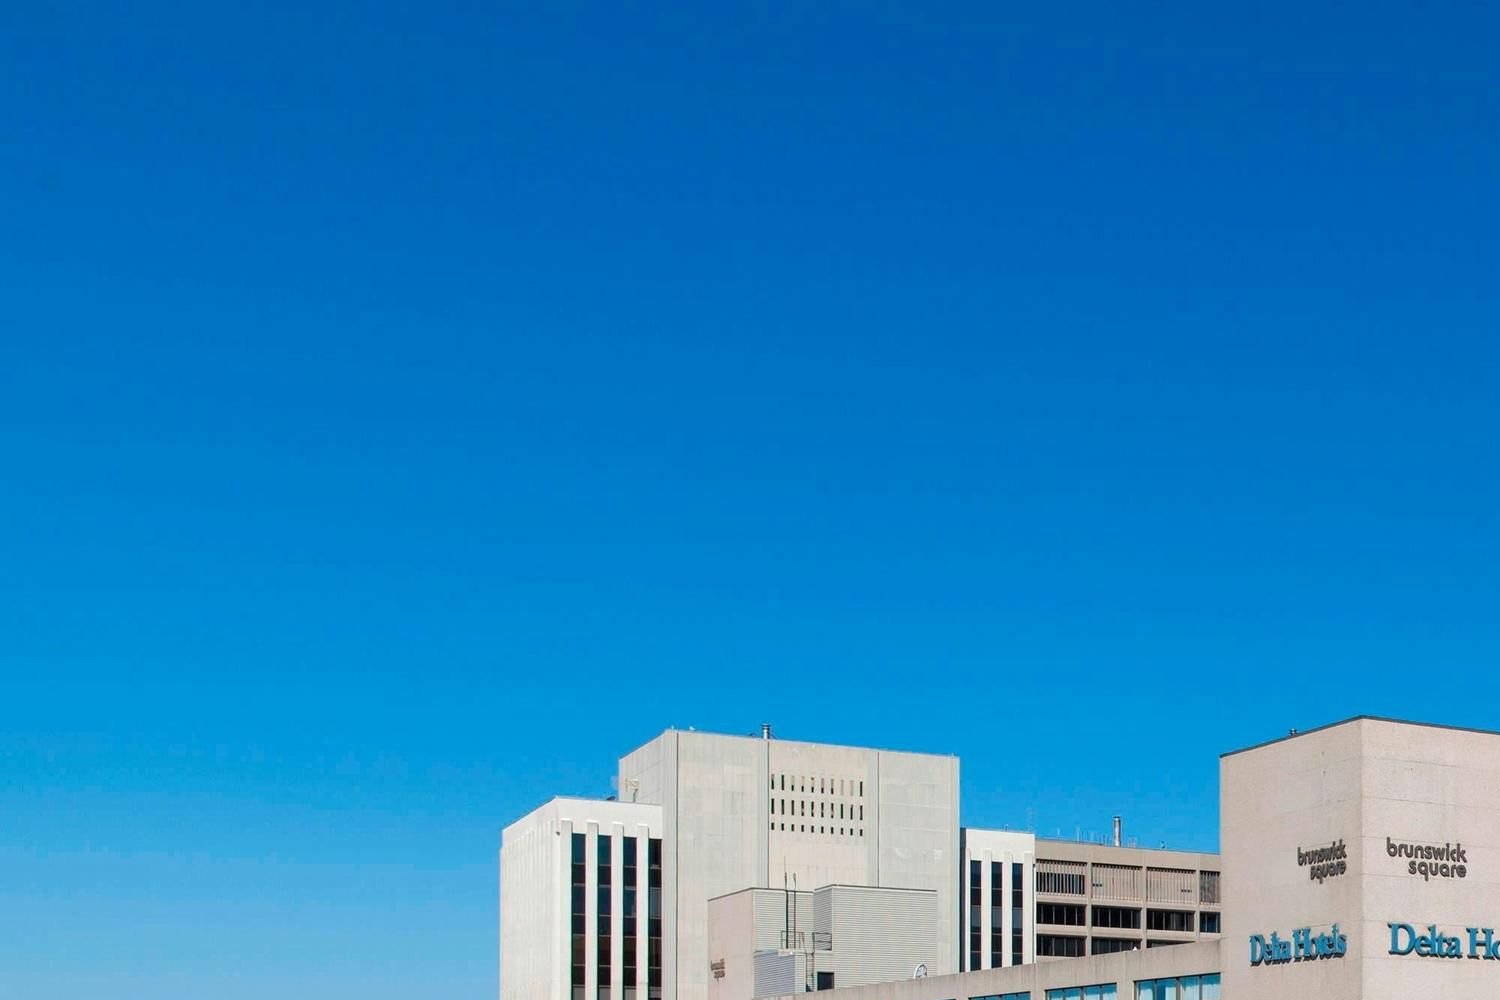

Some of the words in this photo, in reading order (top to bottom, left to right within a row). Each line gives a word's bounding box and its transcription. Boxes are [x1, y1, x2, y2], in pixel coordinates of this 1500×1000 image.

[1297, 839, 1347, 866] brunswick
[1387, 837, 1467, 863] brunswick
[1310, 860, 1347, 884] square
[1408, 861, 1467, 881] square
[1249, 931, 1291, 966] Delta
[1293, 923, 1347, 962] Hotels
[1387, 923, 1463, 959] Delta
